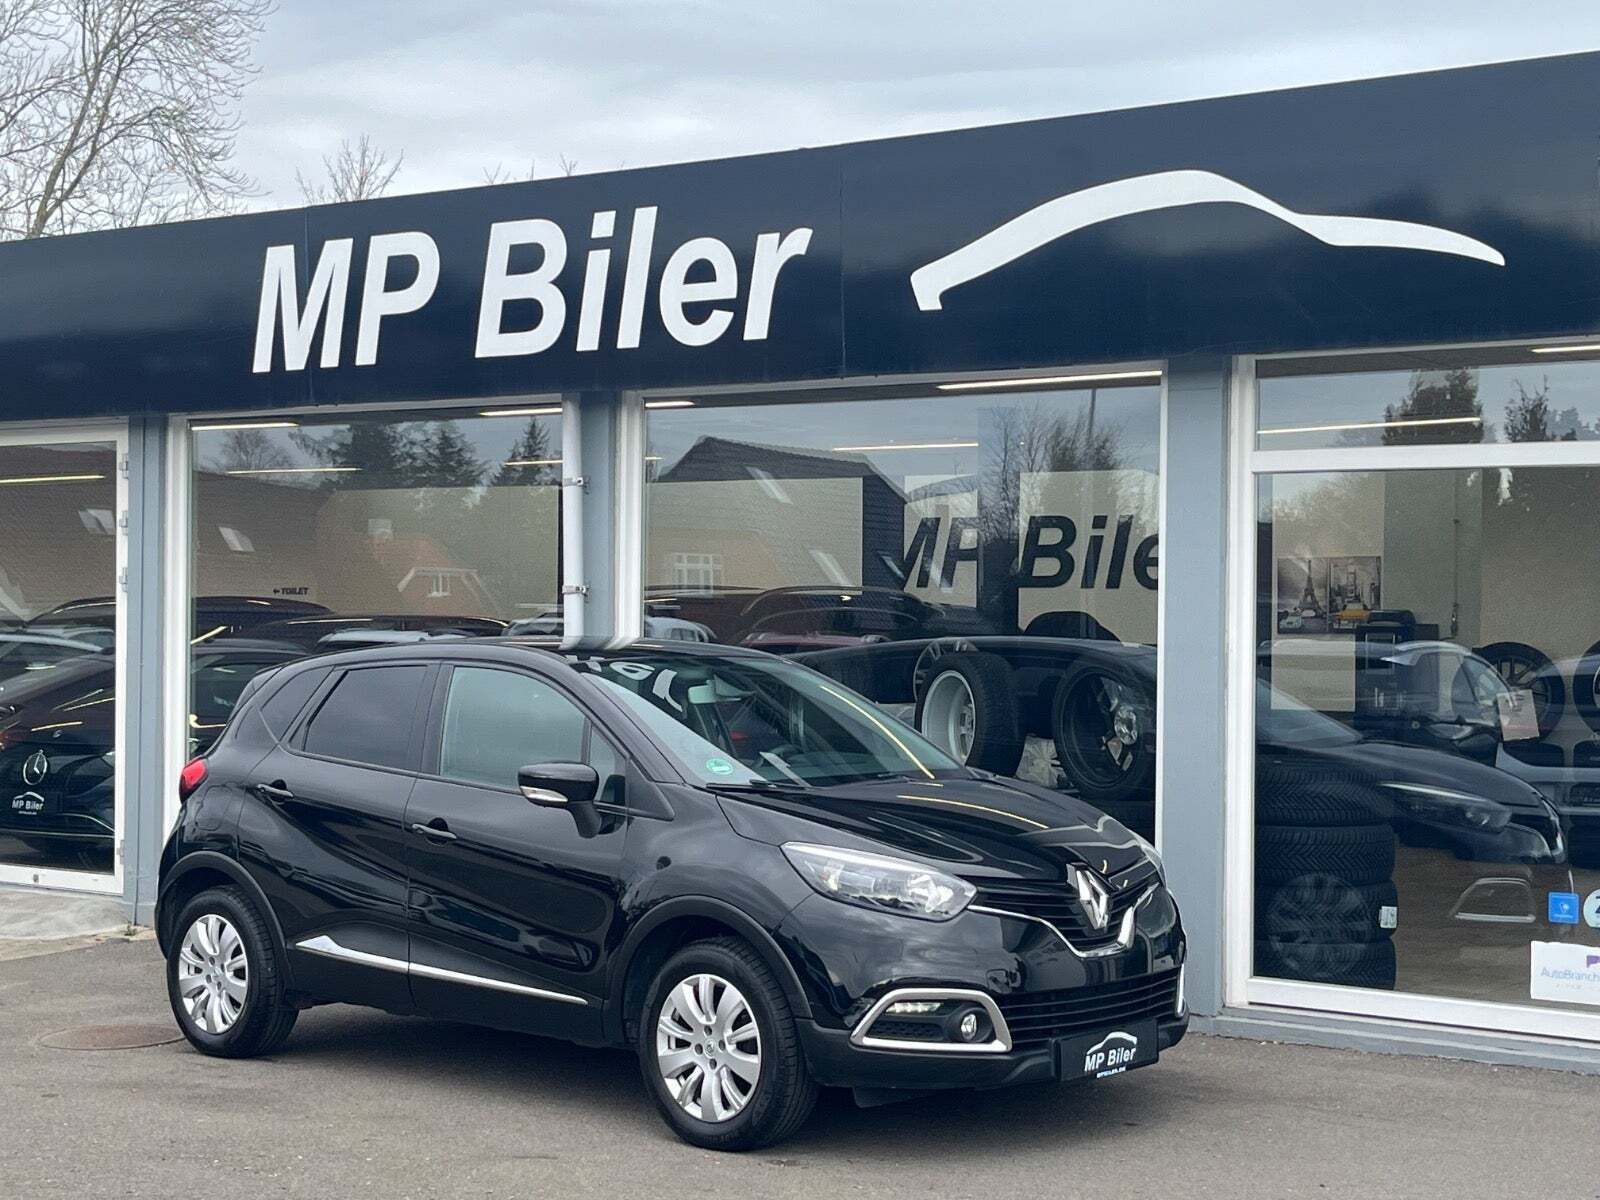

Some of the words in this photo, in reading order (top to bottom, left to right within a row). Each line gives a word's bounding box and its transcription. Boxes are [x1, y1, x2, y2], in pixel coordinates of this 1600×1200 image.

[252, 231, 440, 373] MP
[475, 205, 813, 358] Biler
[281, 587, 308, 595] TOILET
[12, 800, 24, 809] MP
[25, 800, 44, 810] Biler
[1084, 1052, 1105, 1072] MP
[1107, 1047, 1137, 1066] Biler
